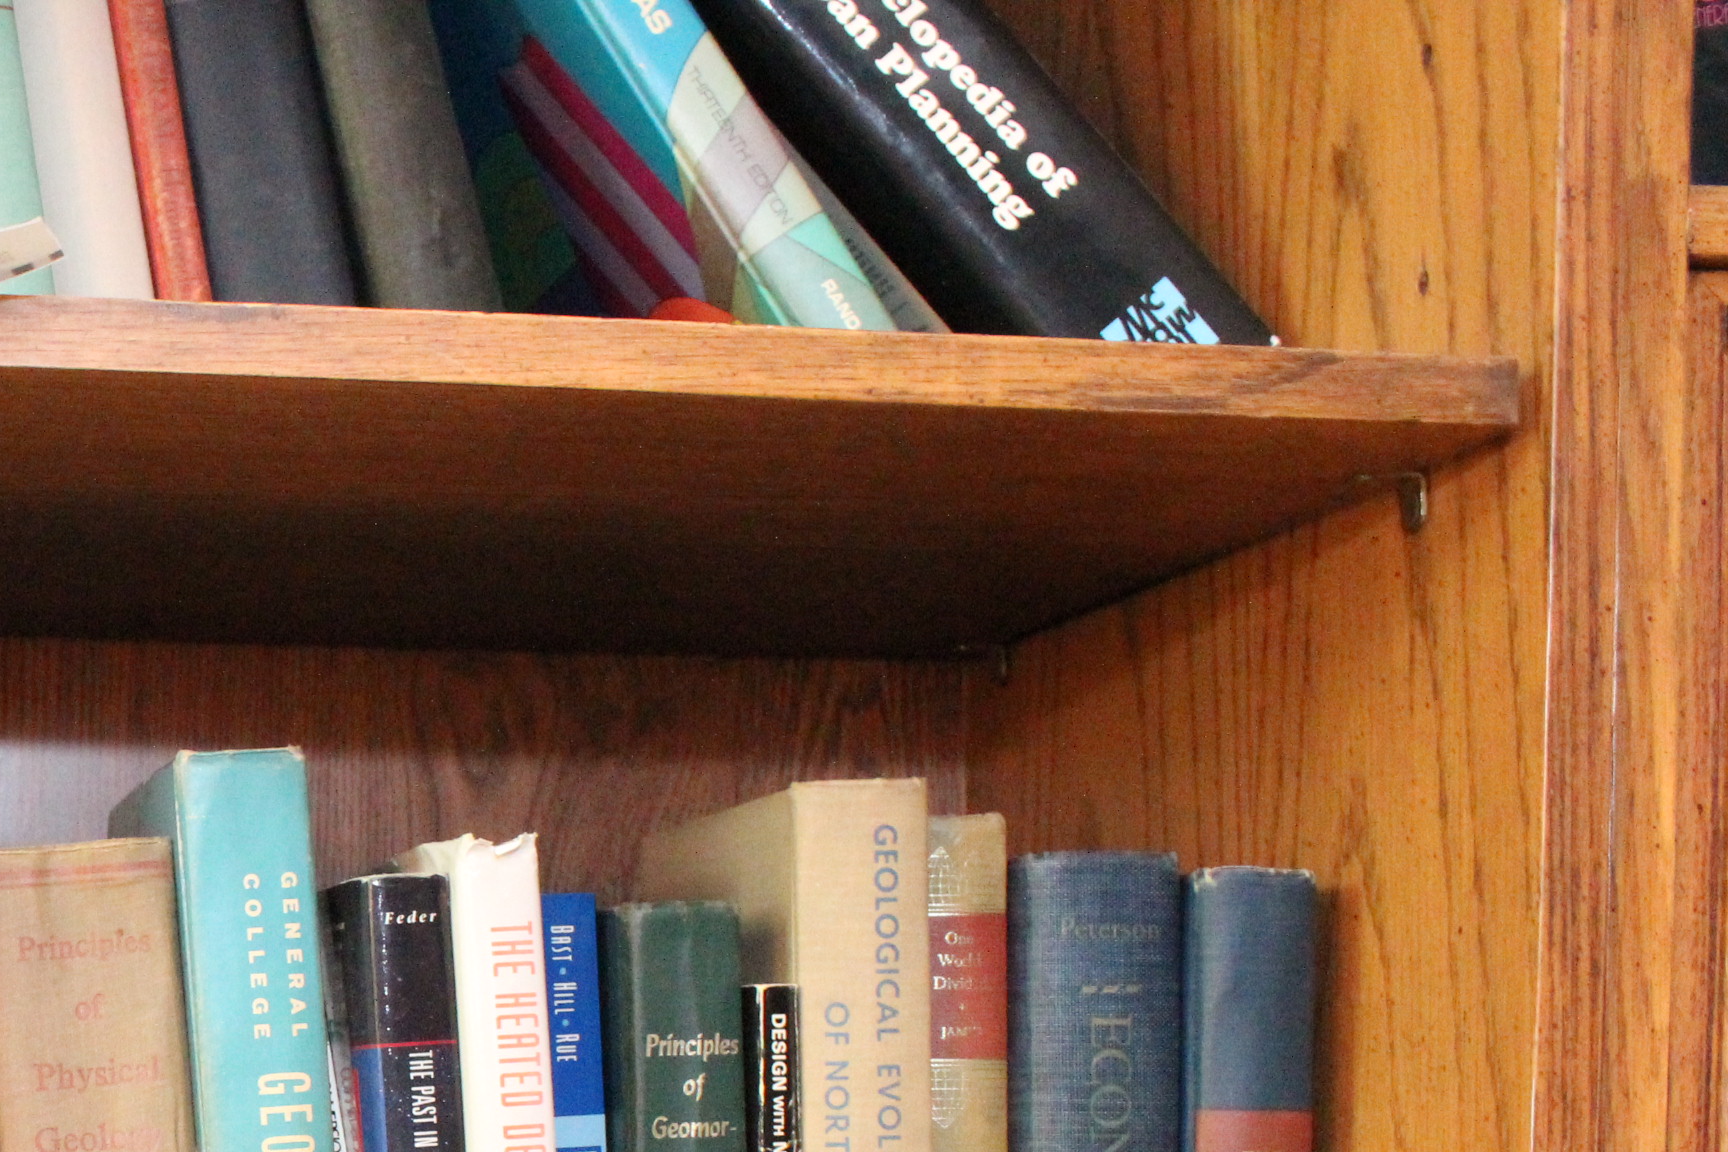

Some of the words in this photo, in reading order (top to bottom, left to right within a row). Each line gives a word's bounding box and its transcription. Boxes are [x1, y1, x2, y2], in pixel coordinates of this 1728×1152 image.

[691, 65, 750, 164] THIRTEENTH
[874, 42, 1035, 231] Planning
[1026, 151, 1079, 199] of
[820, 278, 864, 331] RAND
[384, 911, 438, 926] Feder
[873, 823, 901, 1042] GEOLOGICAL
[1060, 917, 1162, 941] Peterson
[18, 930, 152, 962] Principles
[242, 873, 272, 1040] COLLEGE
[280, 871, 310, 1038] GENERAL
[490, 920, 536, 977] THE
[75, 994, 106, 1021] of
[824, 1001, 851, 1046] OF
[409, 1050, 435, 1080] THE
[495, 991, 544, 1109] HEATED
[645, 1034, 739, 1062] Principles
[771, 1013, 787, 1091] DESIGN
[33, 1056, 164, 1096] Physical
[682, 1073, 706, 1100] of
[411, 1085, 438, 1124] PAST
[772, 1095, 786, 1137] WITH
[413, 1130, 439, 1149] IN
[652, 1116, 737, 1139] Geomor-
